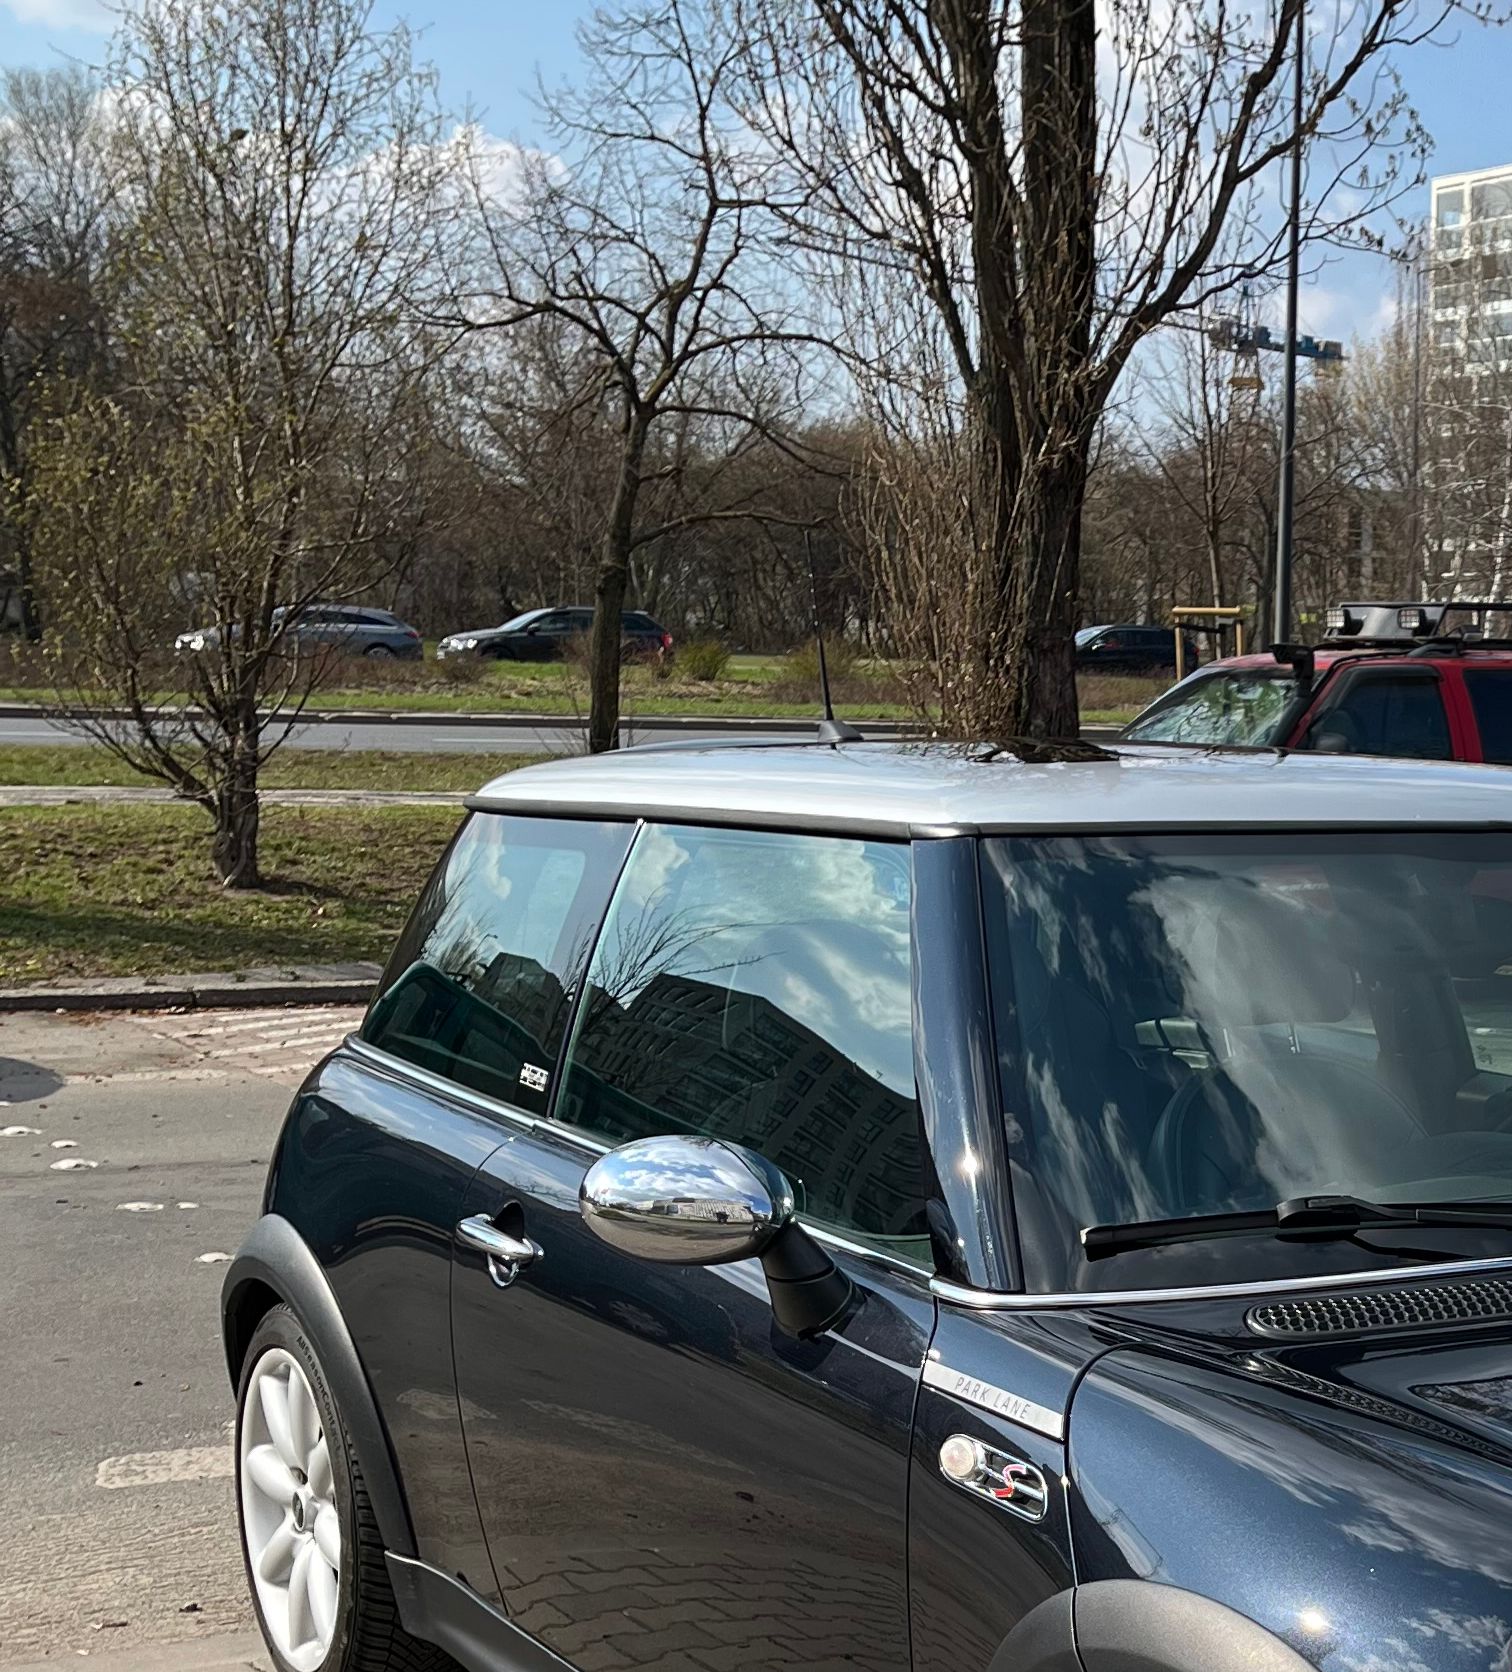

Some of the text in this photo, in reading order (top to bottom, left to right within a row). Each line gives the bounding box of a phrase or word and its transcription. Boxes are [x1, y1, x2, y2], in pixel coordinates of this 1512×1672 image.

[954, 1376, 1031, 1420] PARK LANE
[989, 1463, 1028, 1499] S
